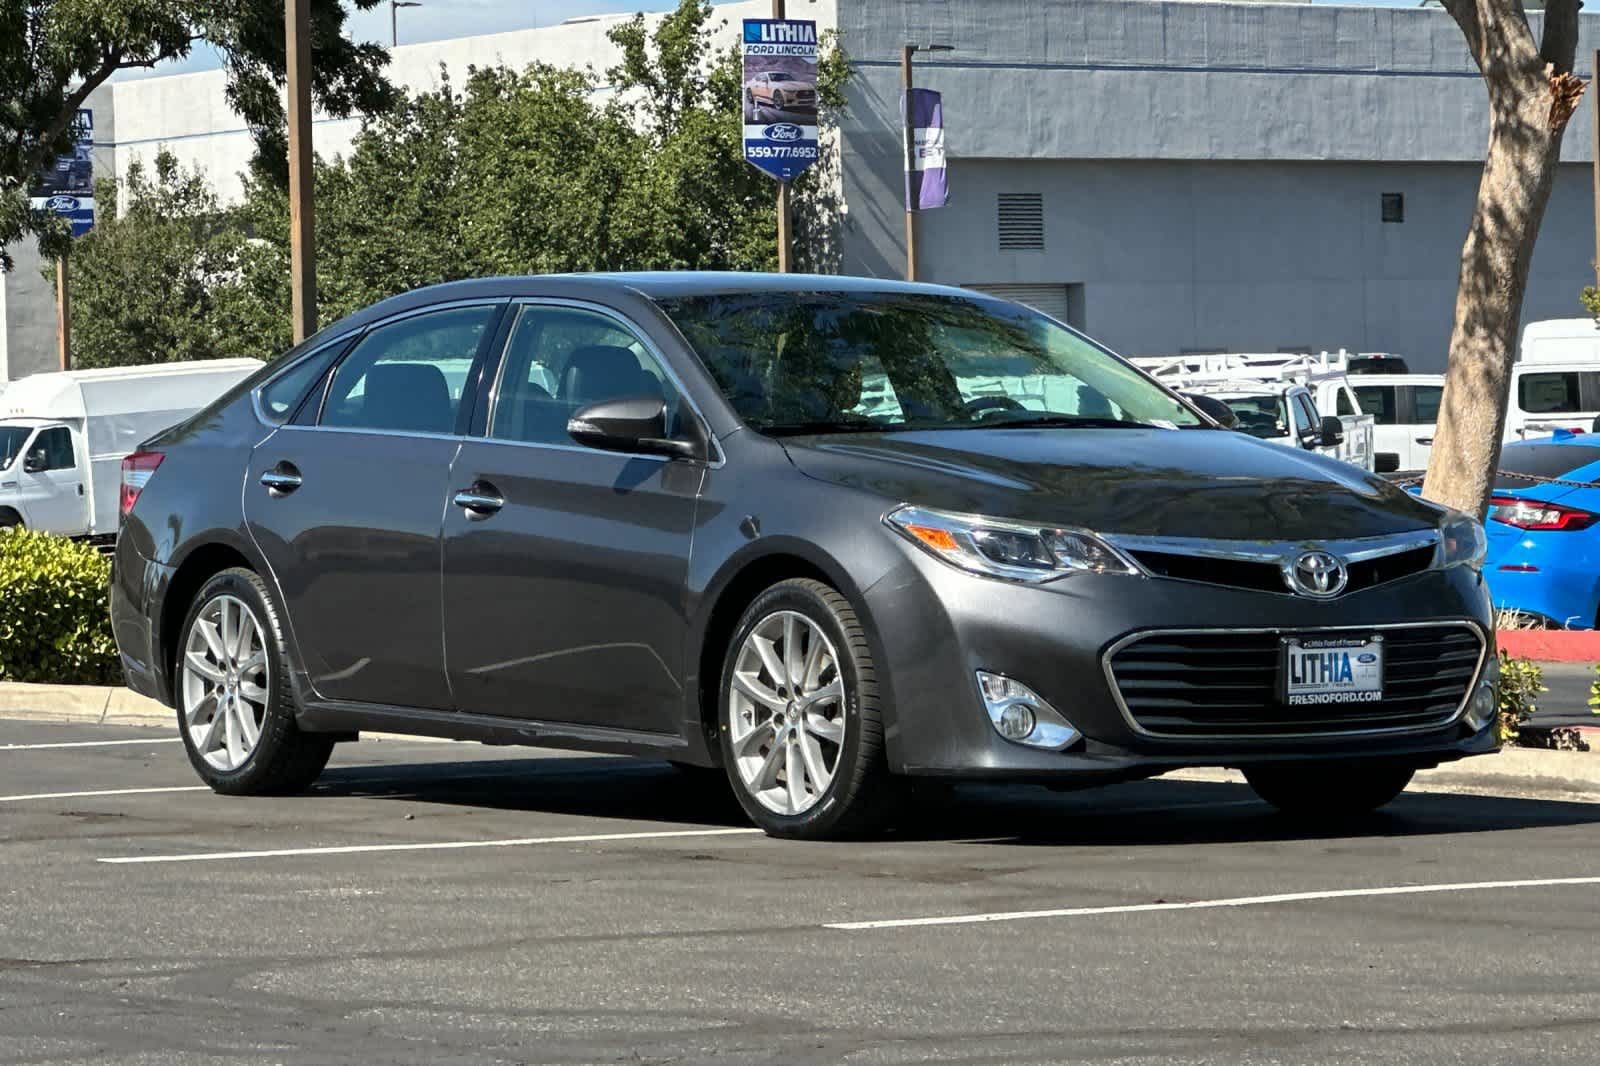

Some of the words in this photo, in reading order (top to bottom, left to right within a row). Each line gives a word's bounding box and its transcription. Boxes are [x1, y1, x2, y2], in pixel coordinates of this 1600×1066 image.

[761, 23, 815, 42] LITHIA
[746, 45, 774, 54] FORD
[776, 45, 815, 55] LINCOLN
[771, 125, 797, 139] Ford
[748, 146, 816, 158] 559.777.6952
[1291, 652, 1353, 683] LITHIA
[1289, 691, 1382, 705] FRESNOFORD.COM
